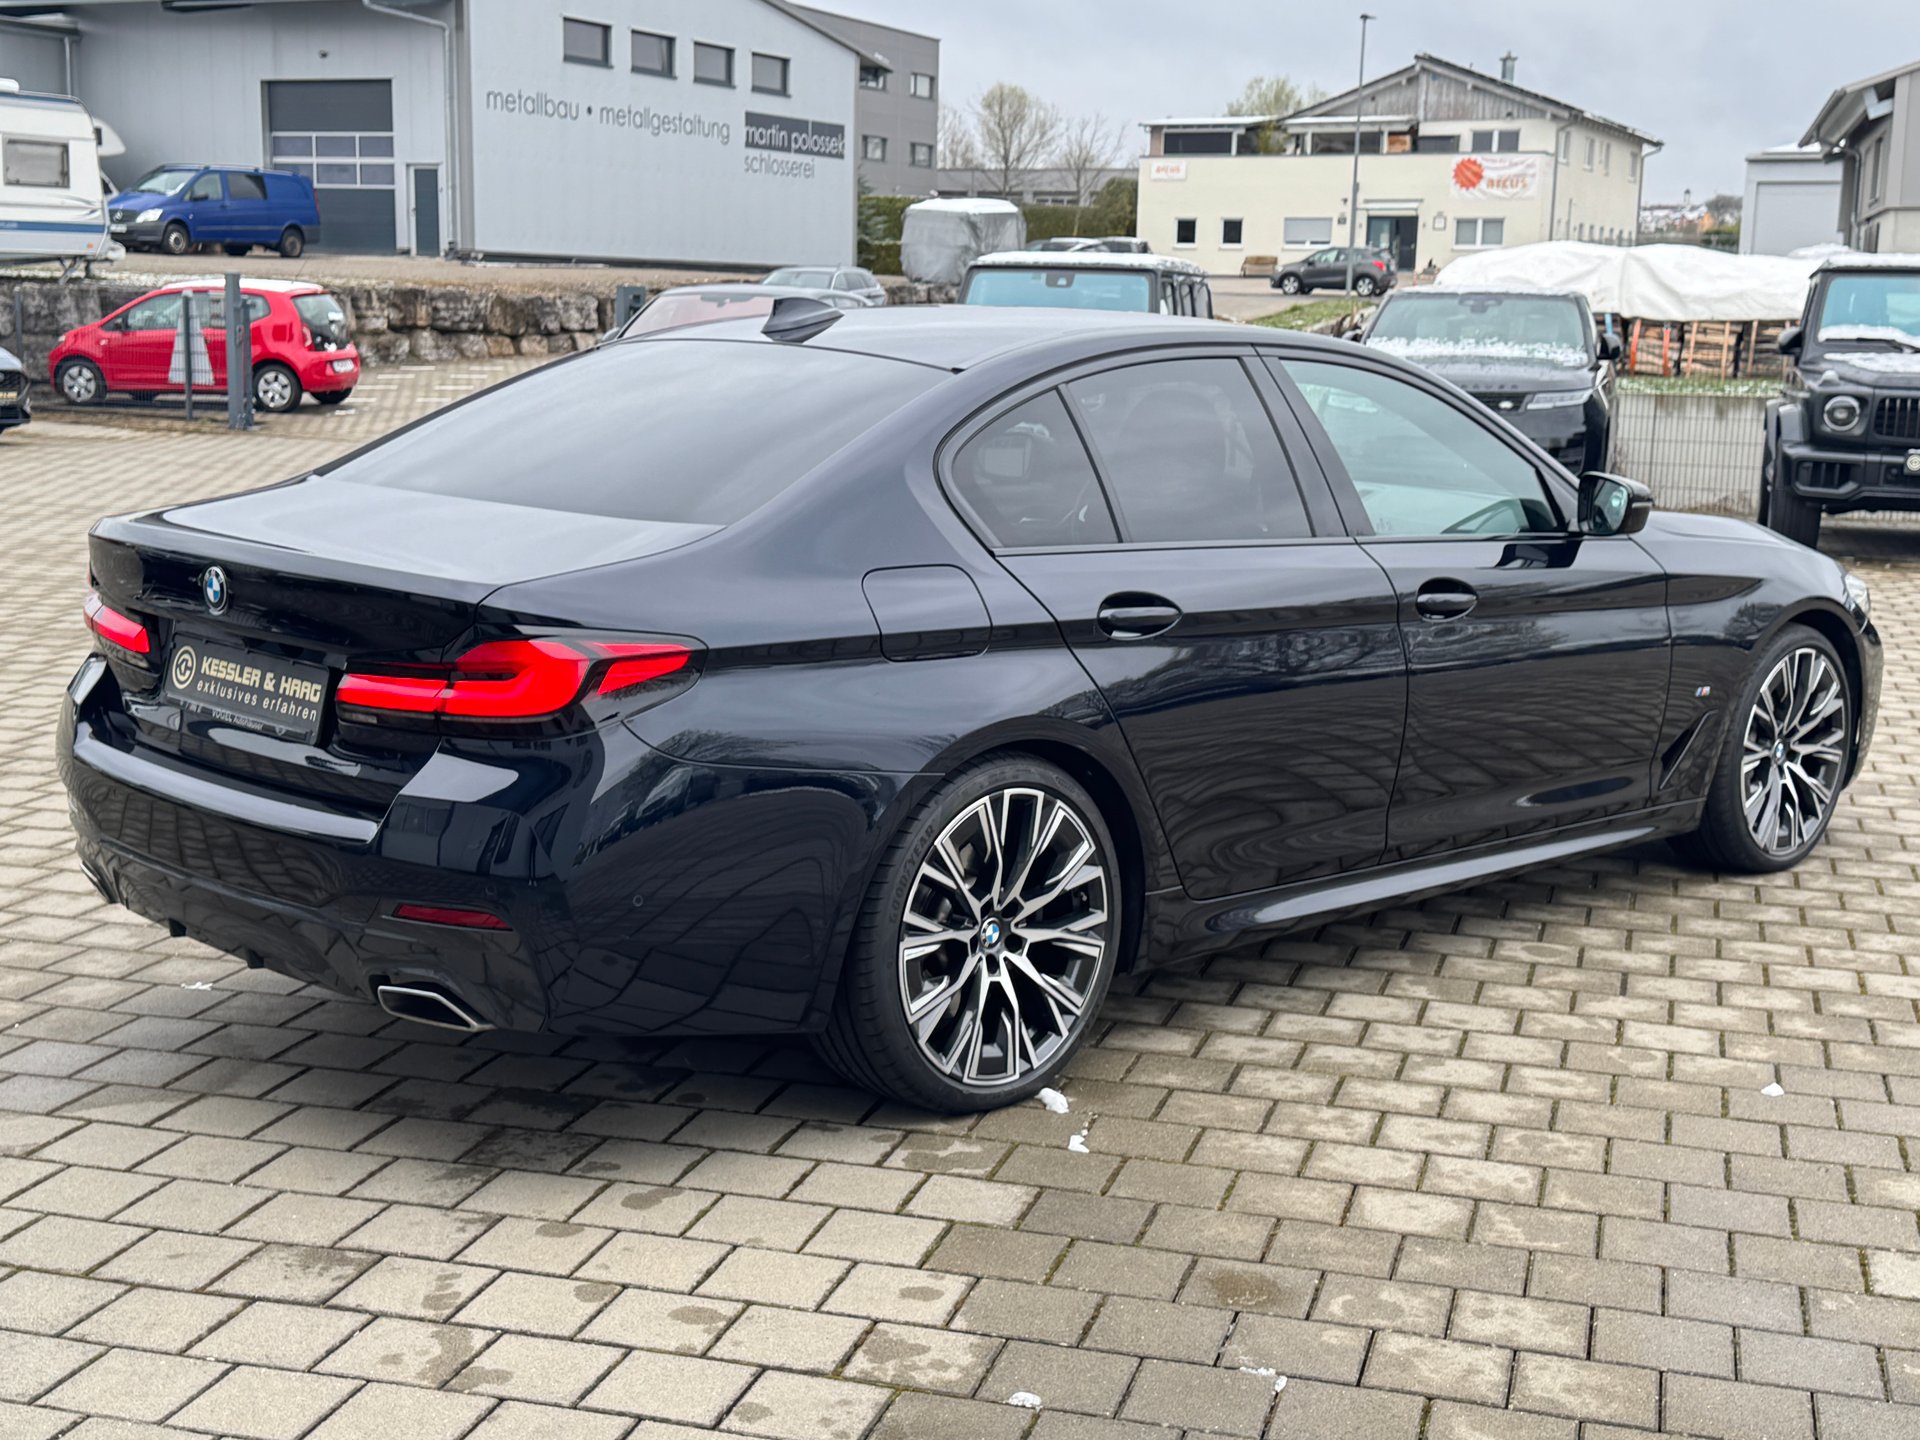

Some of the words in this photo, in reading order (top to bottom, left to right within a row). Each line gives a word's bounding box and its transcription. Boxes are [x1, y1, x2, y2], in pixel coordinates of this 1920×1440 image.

[486, 88, 579, 121] metallbau
[600, 103, 731, 146] metallgestaltung
[745, 124, 789, 150] martin
[791, 122, 845, 155] polossek
[744, 152, 815, 180] schlosserei
[197, 680, 258, 706] exklusives
[262, 696, 317, 722] erfahren
[201, 656, 262, 688] KESSLER
[263, 672, 276, 692] &
[279, 675, 322, 703] HAAG
[888, 824, 936, 924] GOODYEAR
